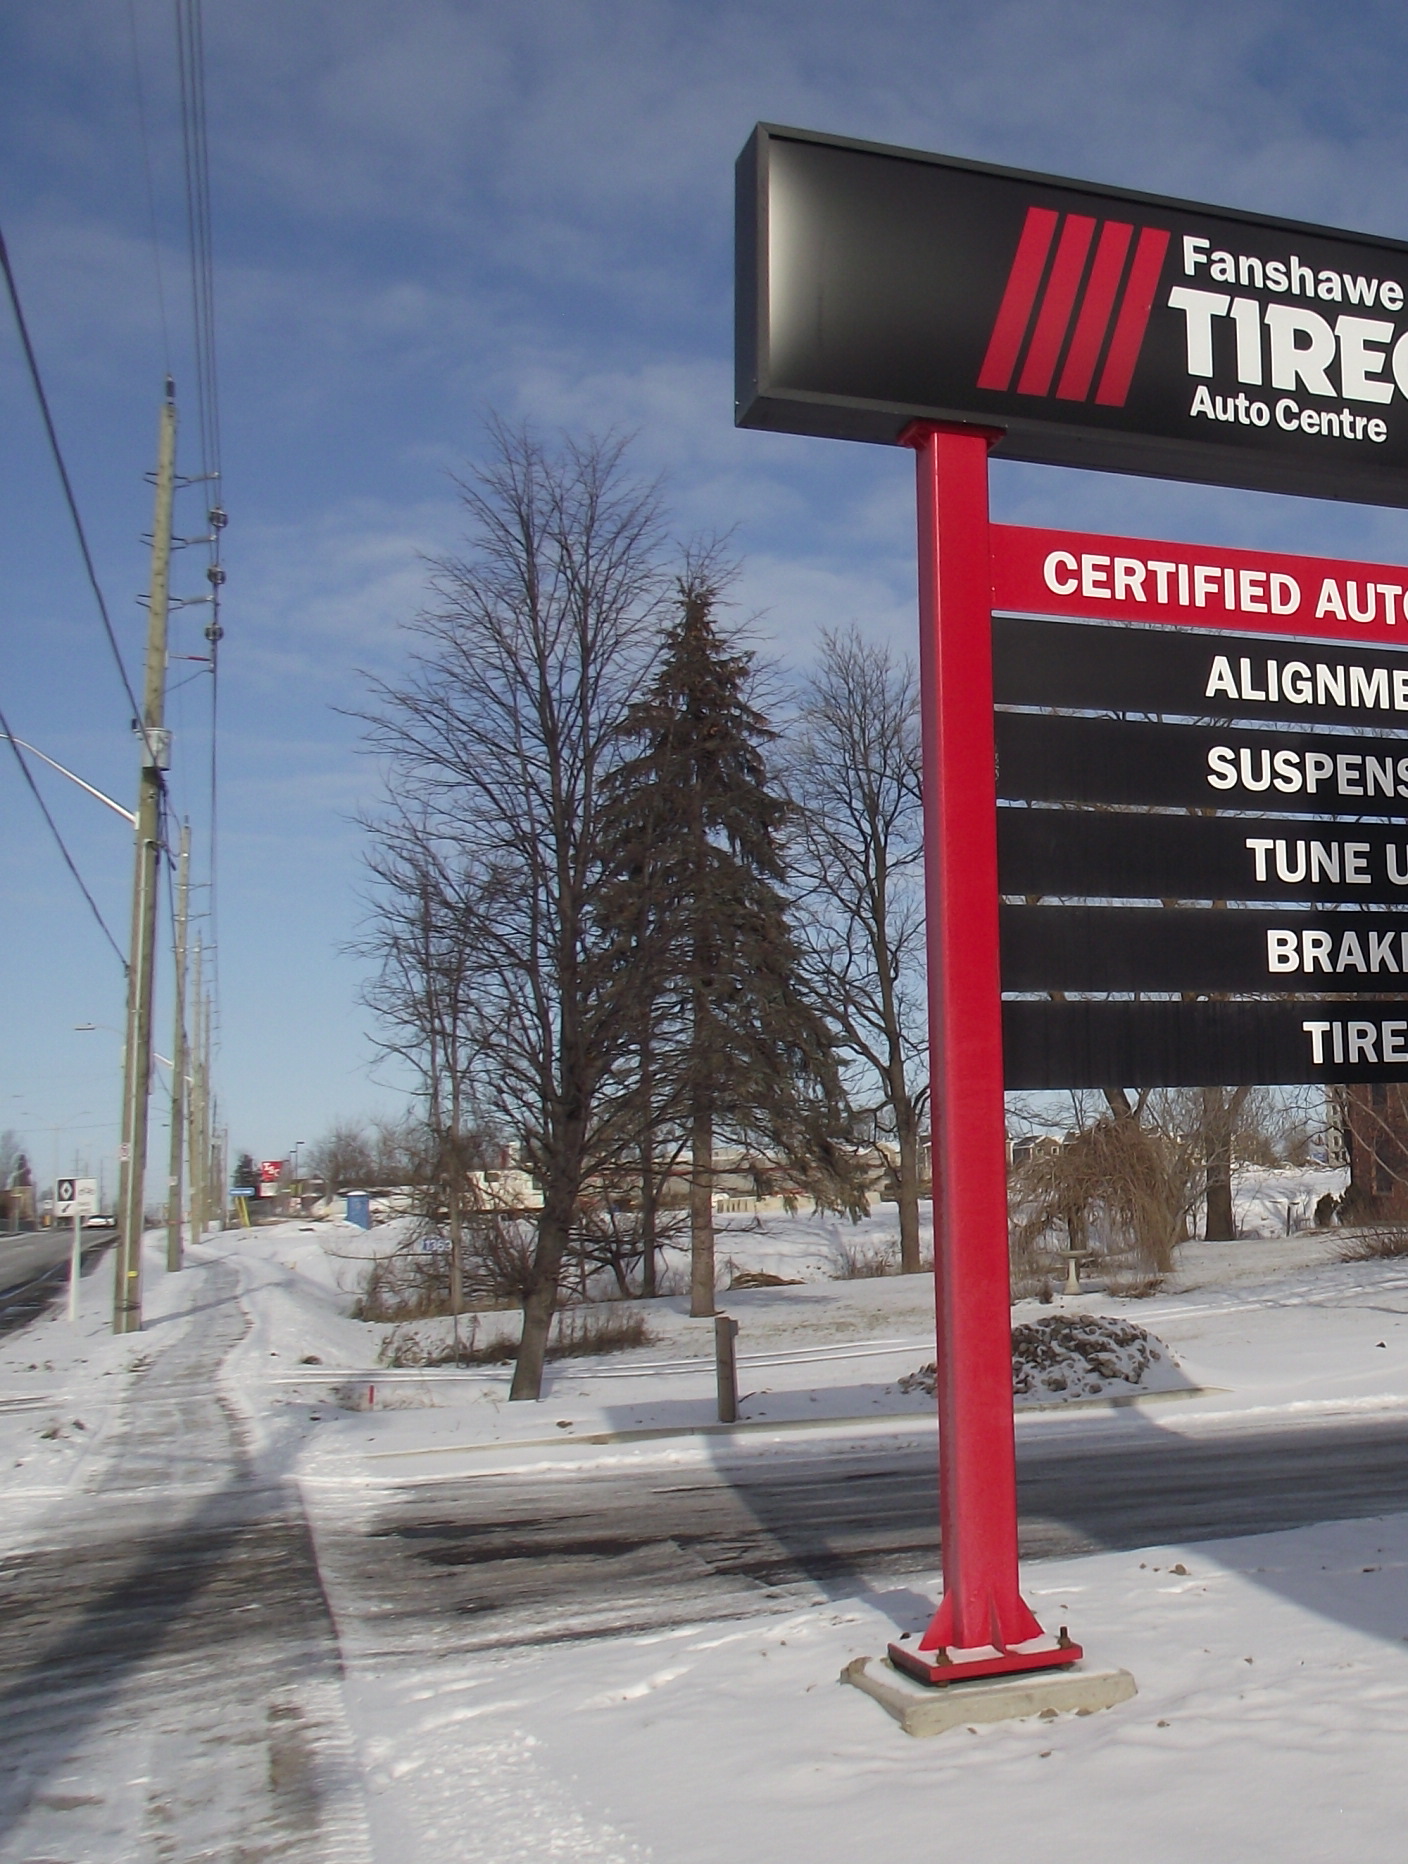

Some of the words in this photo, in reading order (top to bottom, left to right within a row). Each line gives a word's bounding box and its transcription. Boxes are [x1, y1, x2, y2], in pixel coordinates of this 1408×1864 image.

[1182, 235, 1404, 311] Fanshawe
[1189, 385, 1271, 427] Auto
[1275, 398, 1388, 443] Centre
[1043, 550, 1301, 615] CERTIFIED
[1245, 838, 1372, 884] TUNE
